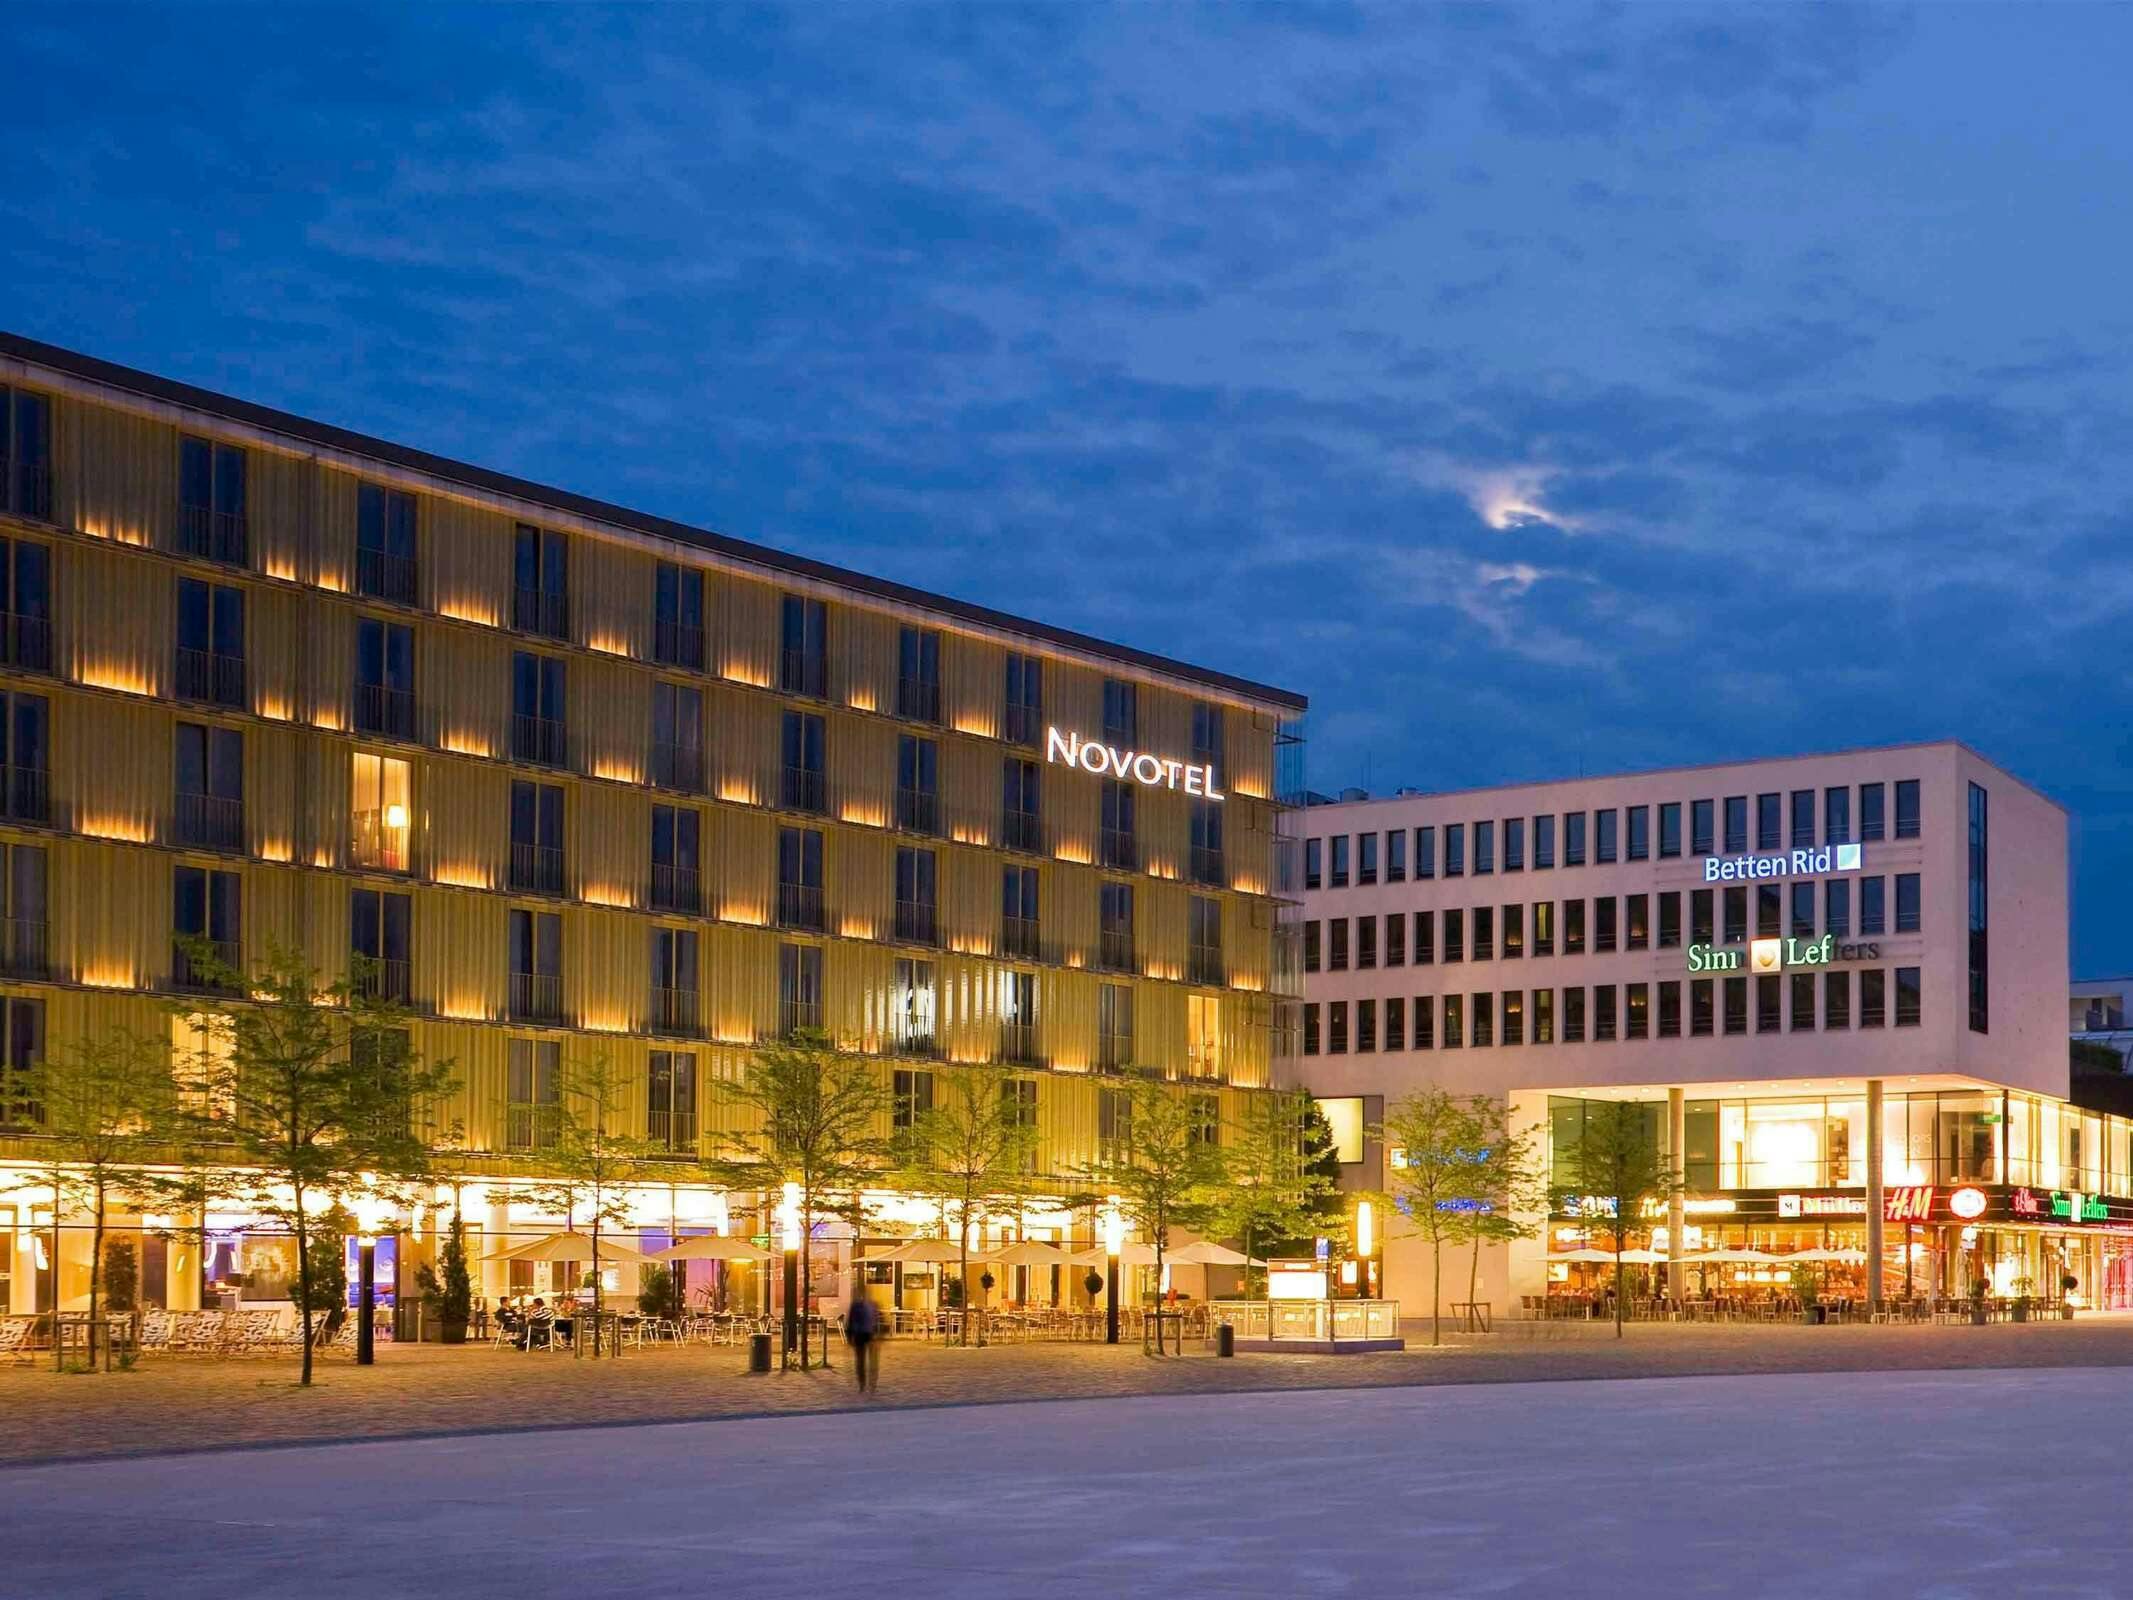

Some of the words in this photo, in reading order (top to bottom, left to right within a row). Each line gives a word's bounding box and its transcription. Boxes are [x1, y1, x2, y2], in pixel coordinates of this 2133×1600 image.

[1047, 726, 1225, 800] NOVOTEL
[1705, 855, 1787, 881] Betten
[1792, 846, 1831, 875] Rid
[1886, 1187, 1933, 1220] H&M
